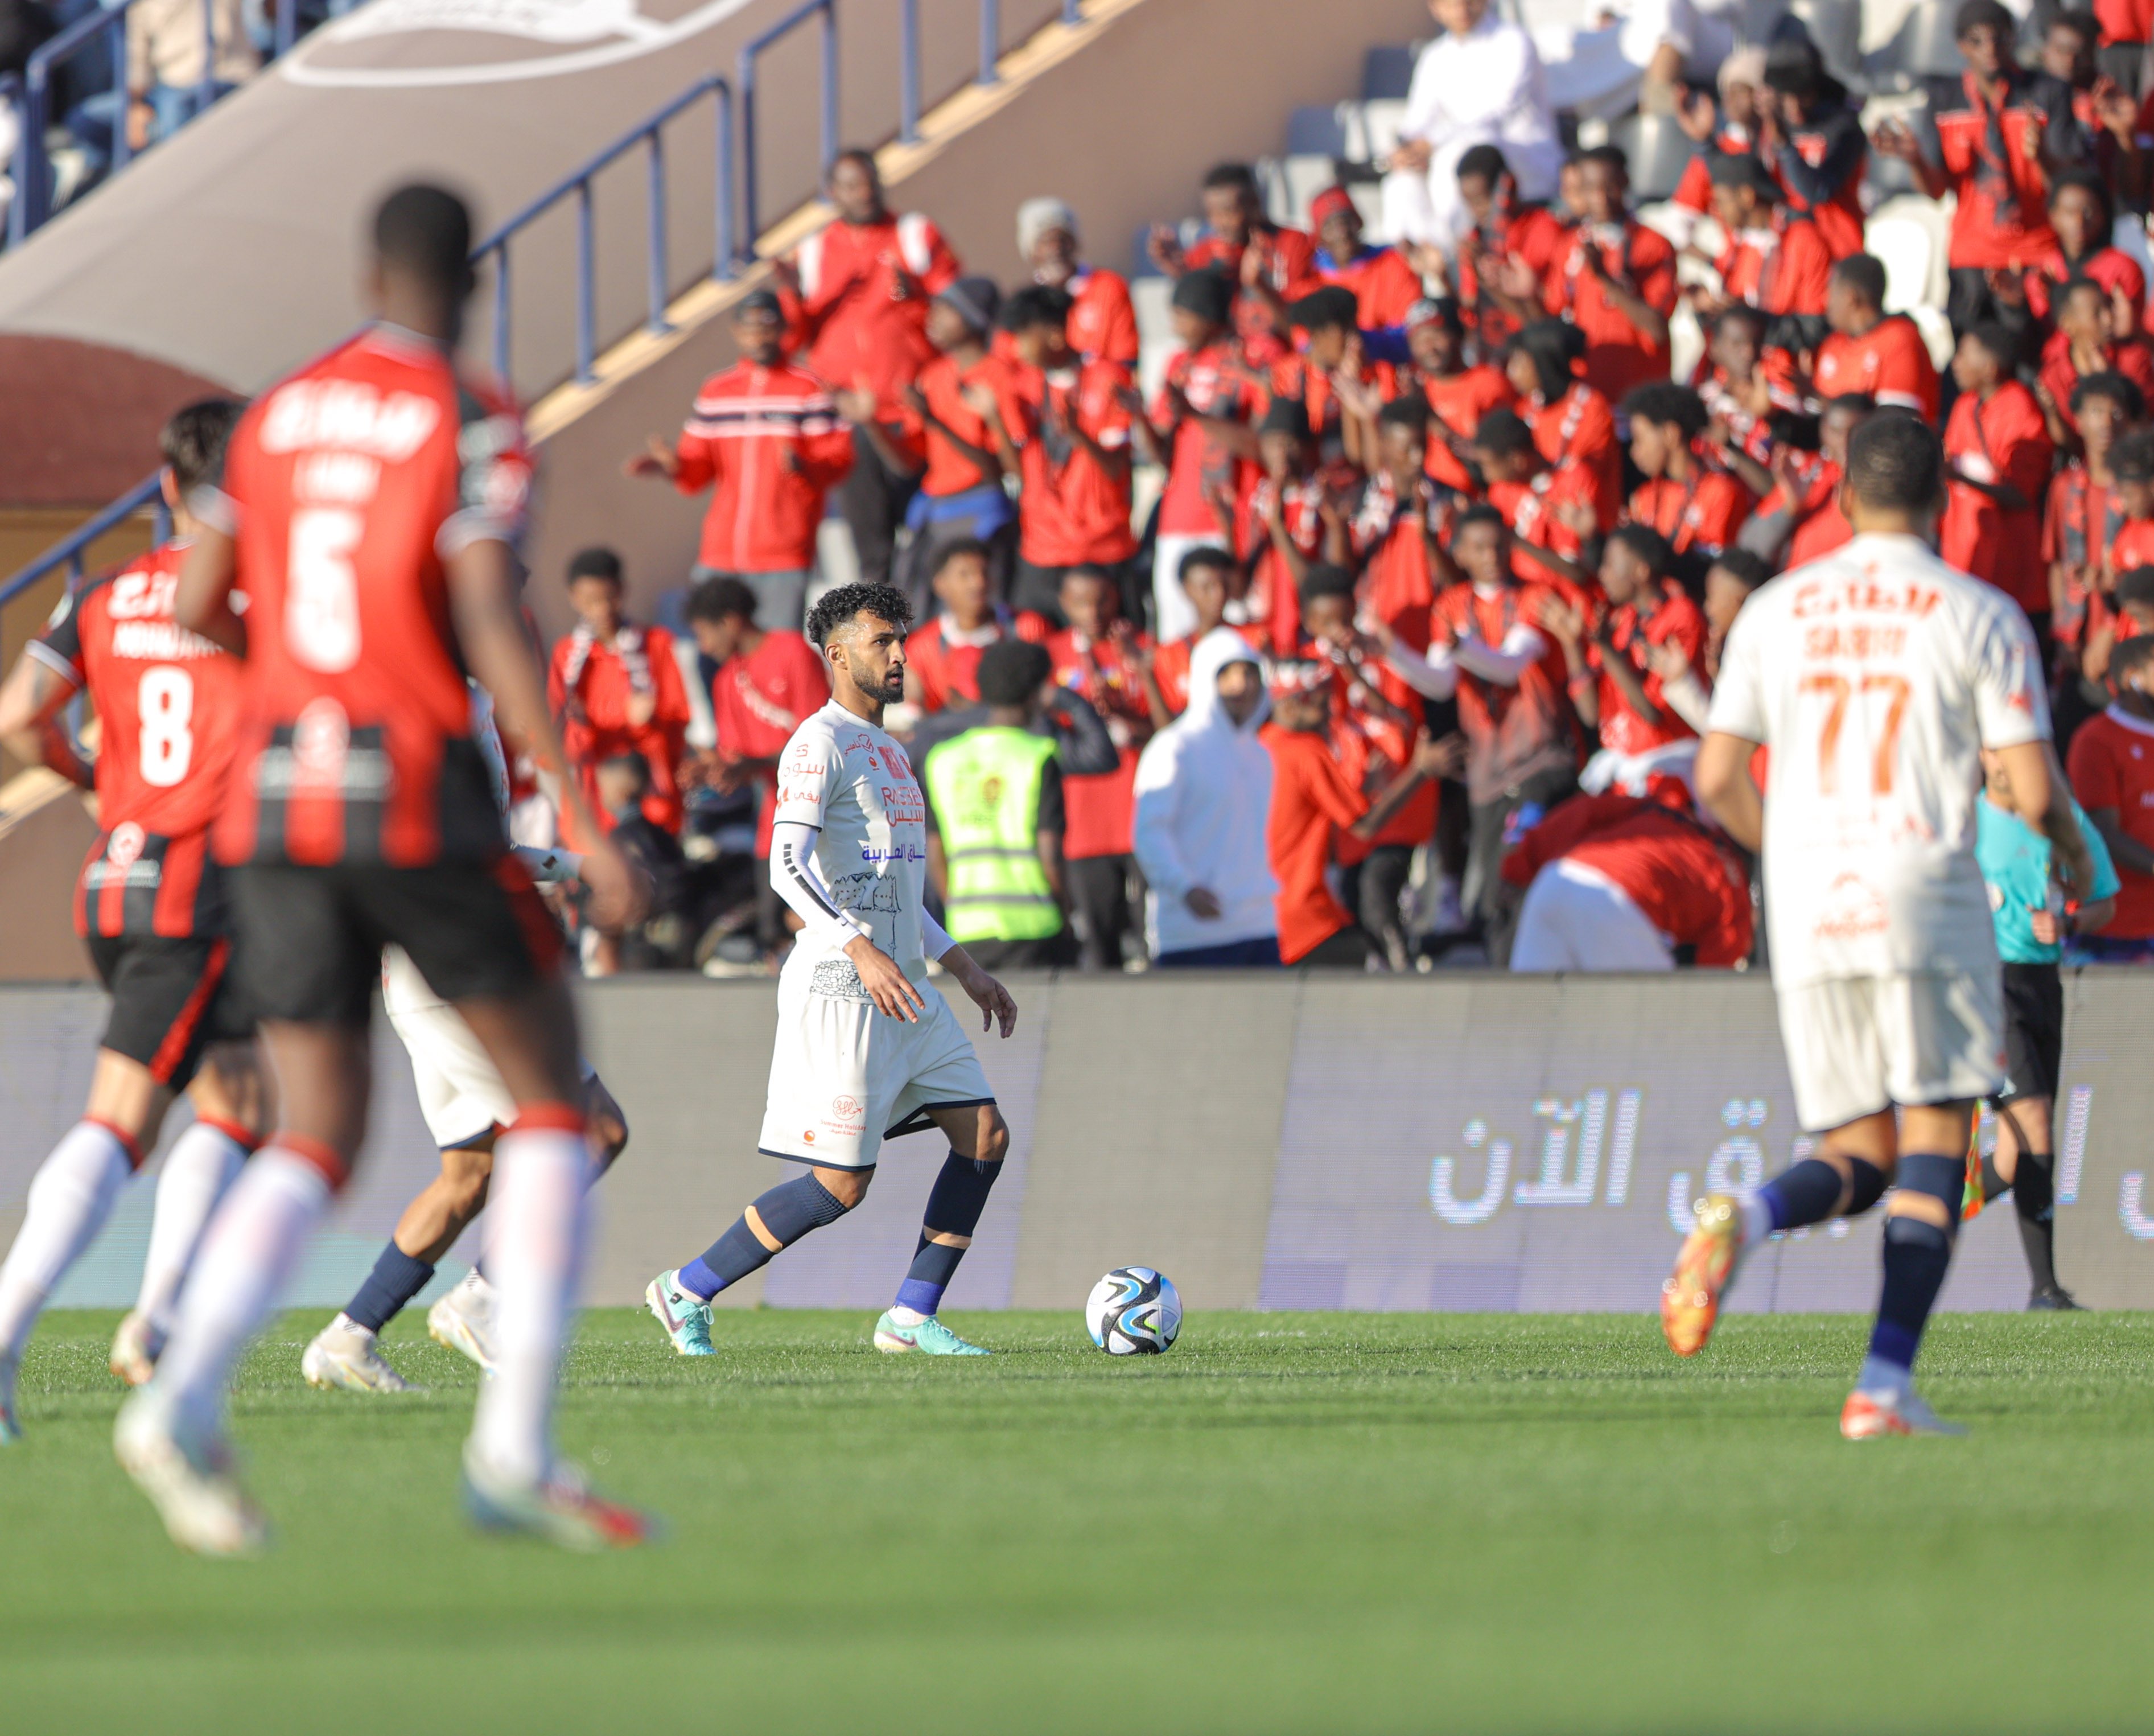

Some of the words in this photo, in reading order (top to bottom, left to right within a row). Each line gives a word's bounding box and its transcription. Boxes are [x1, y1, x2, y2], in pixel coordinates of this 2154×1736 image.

[138, 665, 193, 787] 8
[1799, 673, 1911, 797] 77
[862, 843, 906, 863] العربية
[819, 1119, 843, 1129] Summer
[845, 1124, 867, 1132] Holiday
[1427, 1088, 1642, 1225] الآن
